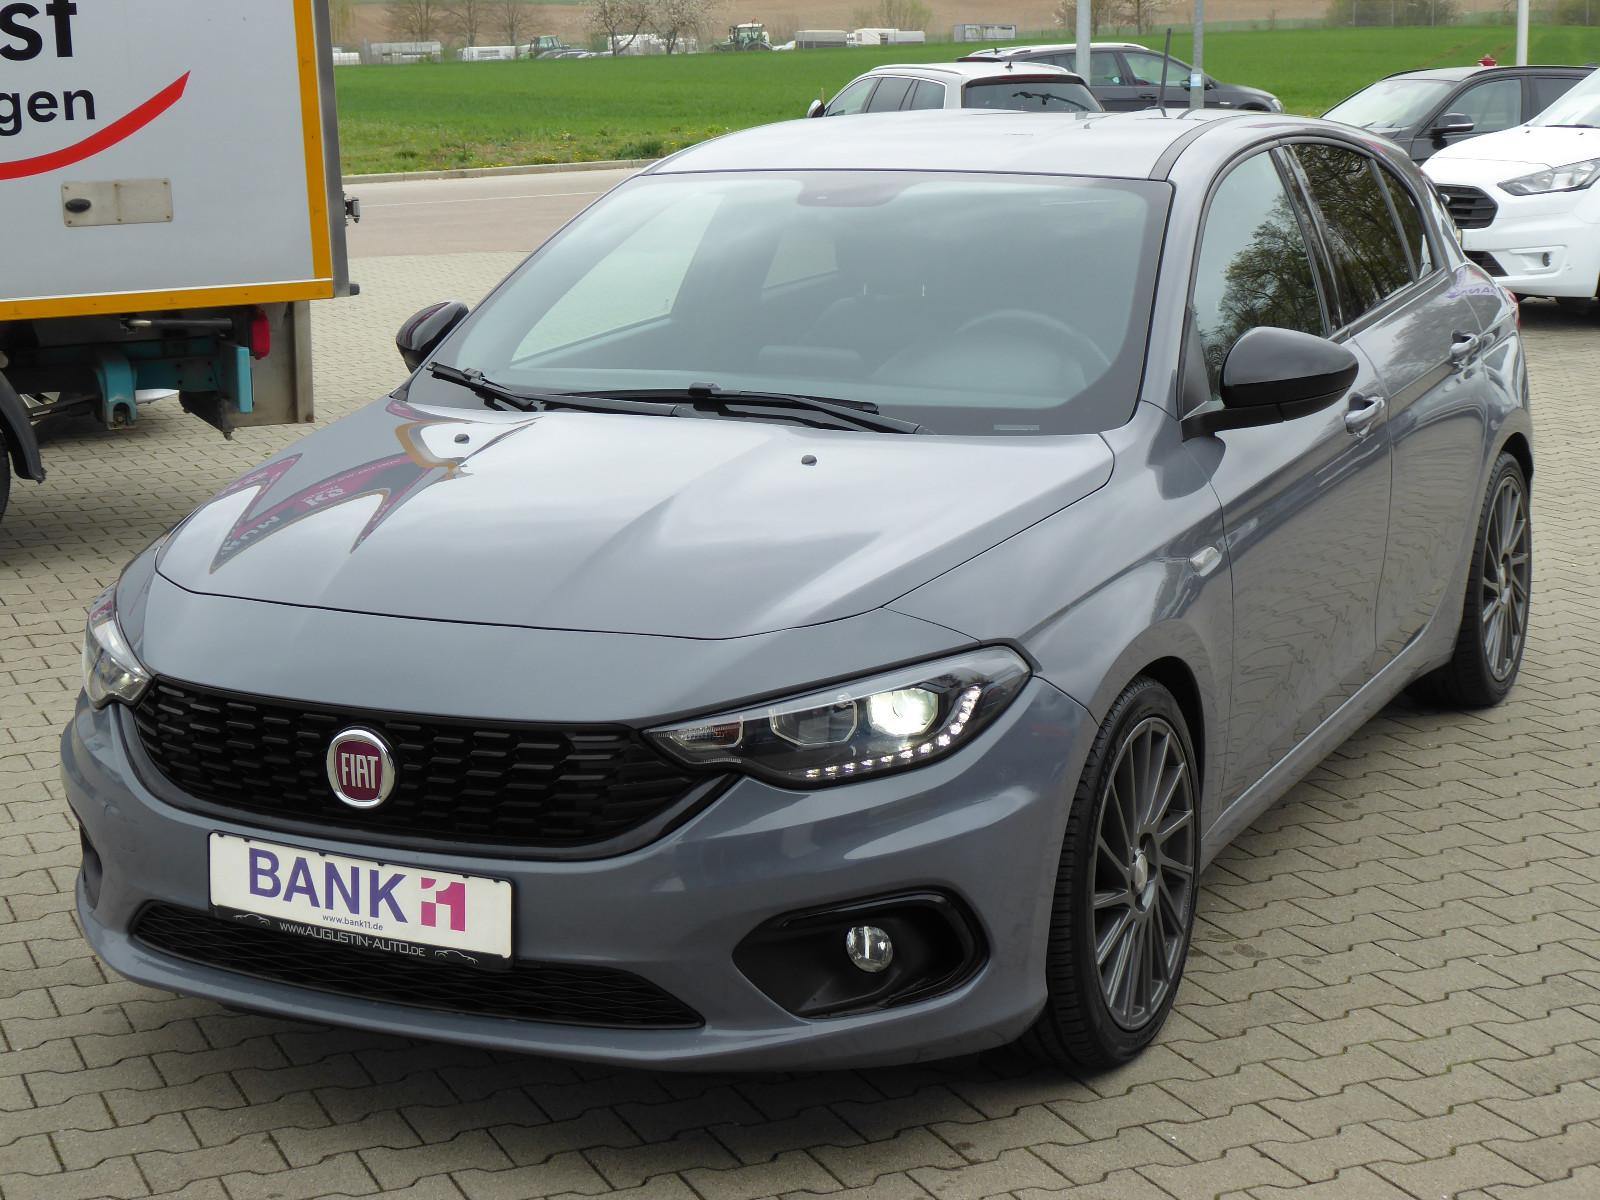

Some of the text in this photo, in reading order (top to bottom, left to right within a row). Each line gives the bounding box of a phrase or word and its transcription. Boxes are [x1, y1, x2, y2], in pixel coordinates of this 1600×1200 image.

[341, 752, 379, 790] FIAT
[248, 847, 409, 924] BANK
[322, 914, 384, 931] www.bank11.de
